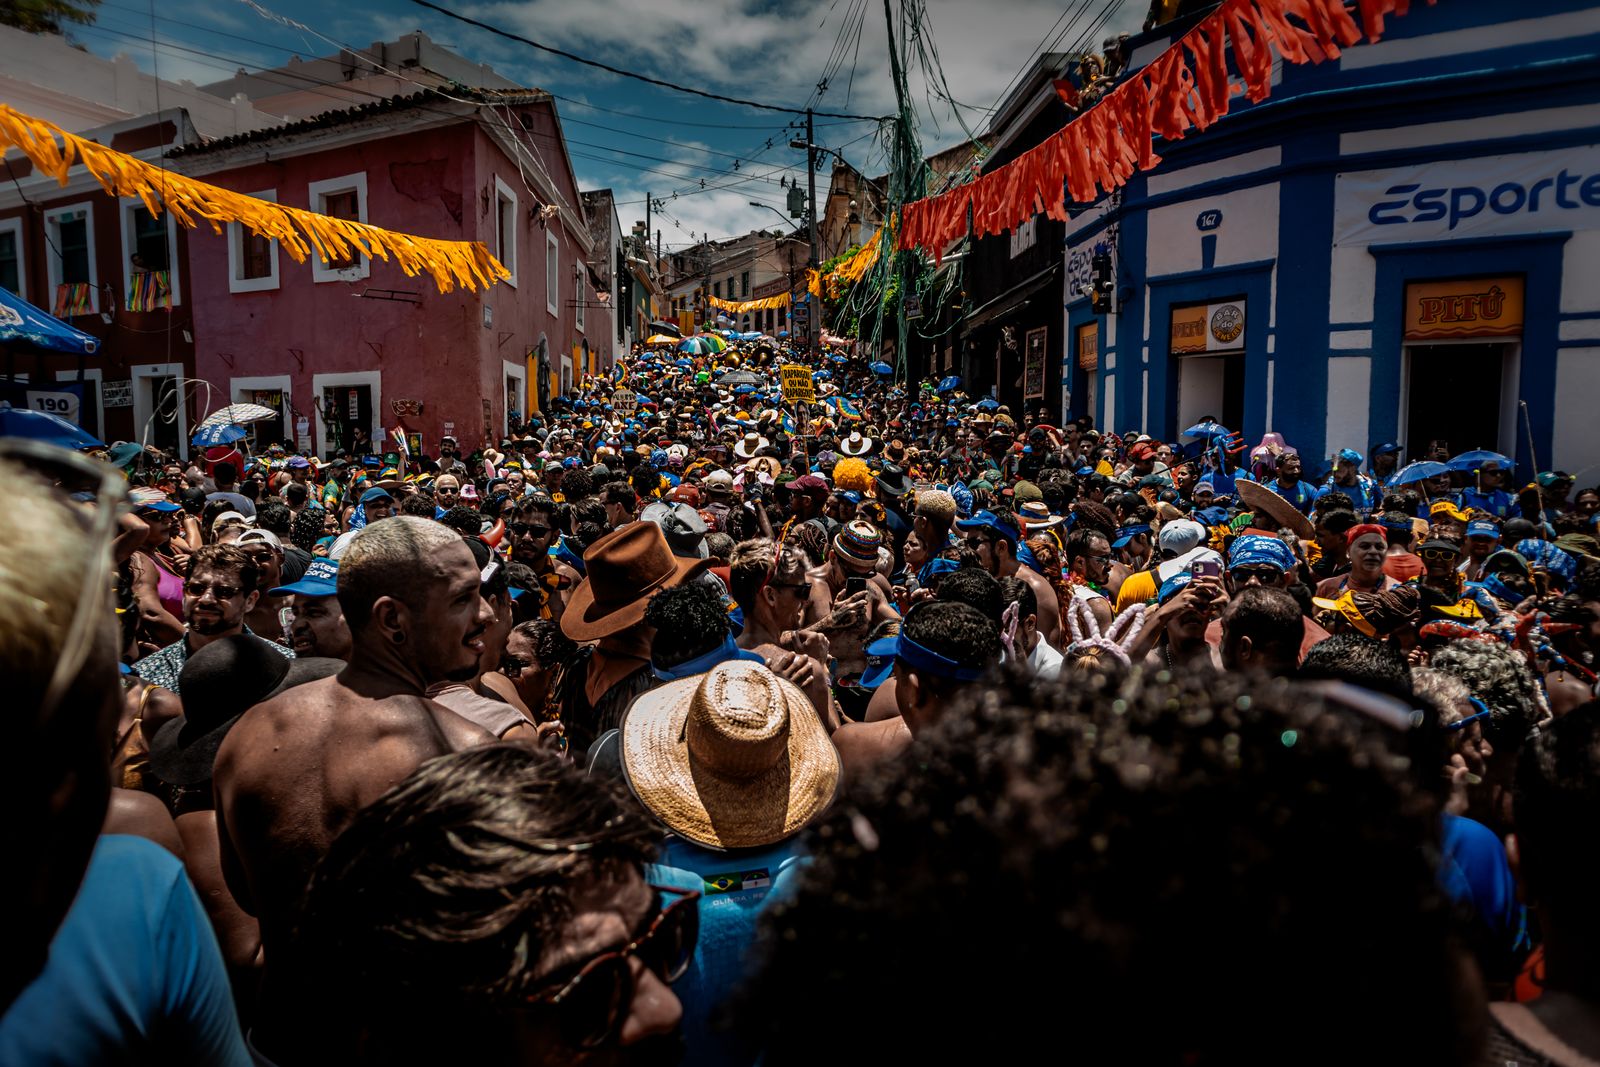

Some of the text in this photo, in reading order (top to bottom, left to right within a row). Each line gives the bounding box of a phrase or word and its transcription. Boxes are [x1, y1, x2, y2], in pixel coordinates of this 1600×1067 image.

[1201, 214, 1218, 227] 167
[1419, 285, 1505, 325] PITÚ
[1216, 309, 1239, 320] BAR
[1221, 320, 1233, 328] do
[37, 398, 69, 411] 190
[712, 896, 747, 906] OLINDA
